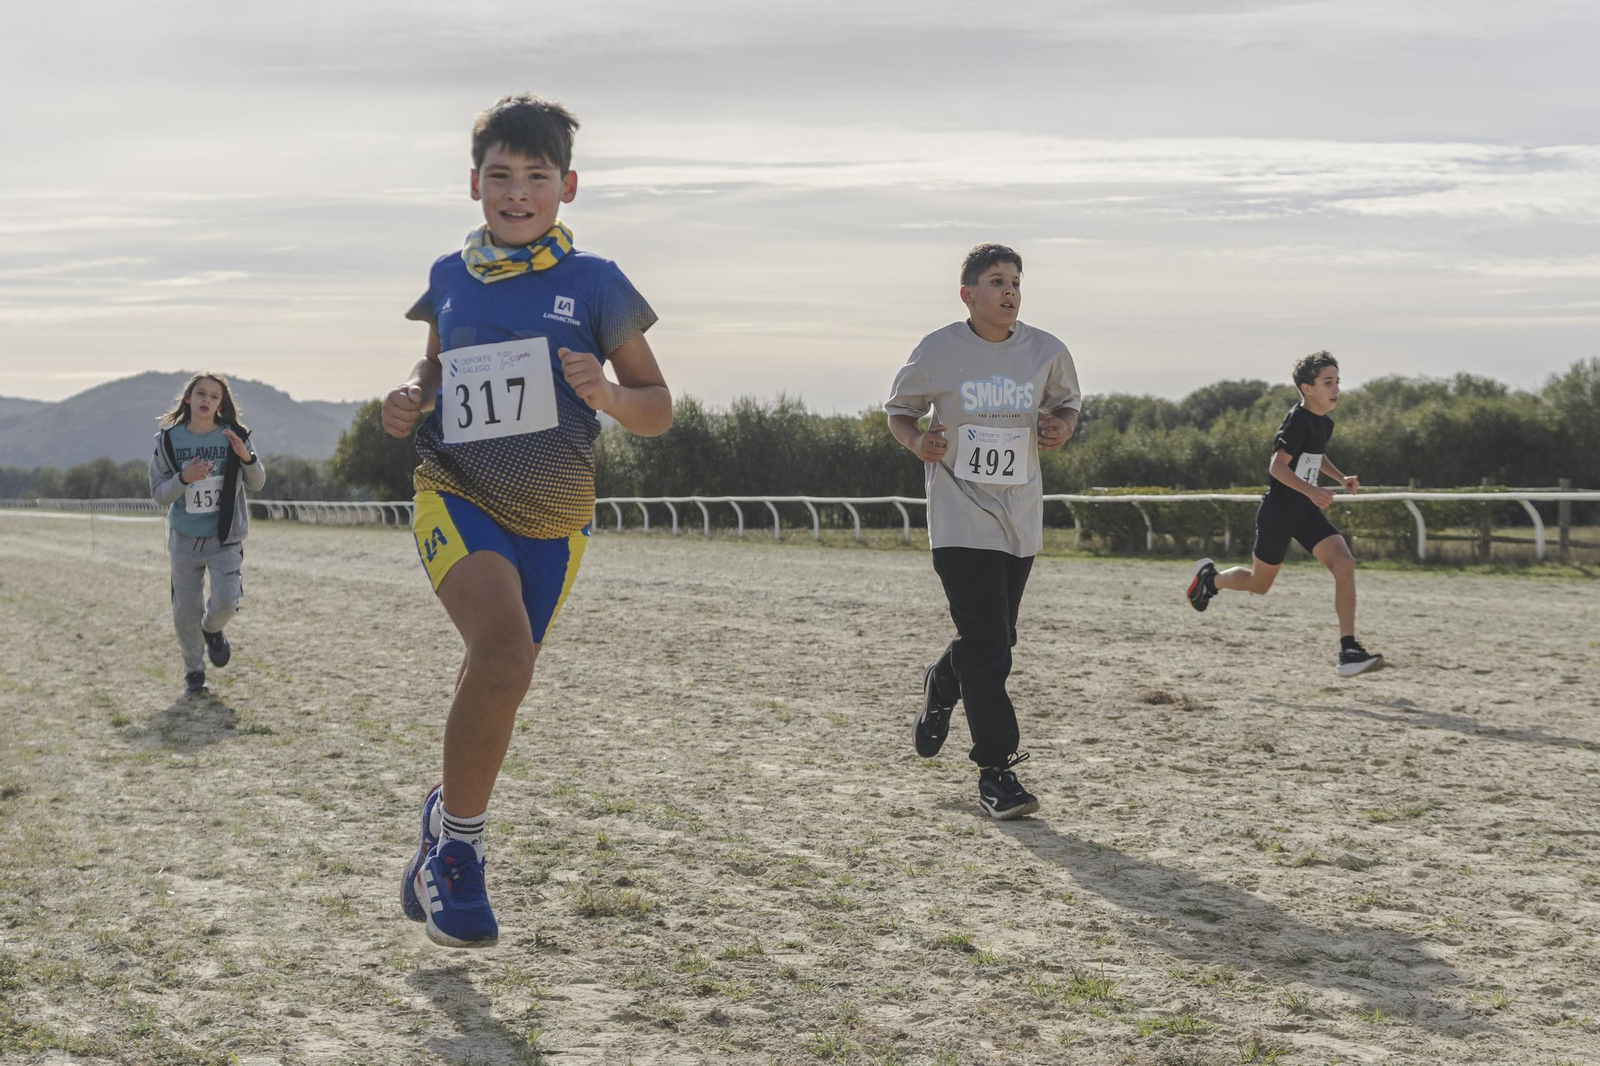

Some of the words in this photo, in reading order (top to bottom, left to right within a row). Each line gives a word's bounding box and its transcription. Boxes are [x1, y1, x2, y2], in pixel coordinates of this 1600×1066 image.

[542, 312, 581, 326] LIMIACTIVA
[461, 355, 492, 365] DEPORTE
[462, 364, 490, 374] GALEGO
[961, 378, 1035, 411] SMURFS
[455, 376, 526, 429] 317
[176, 446, 228, 461] DELAWAR
[968, 446, 1015, 477] 492
